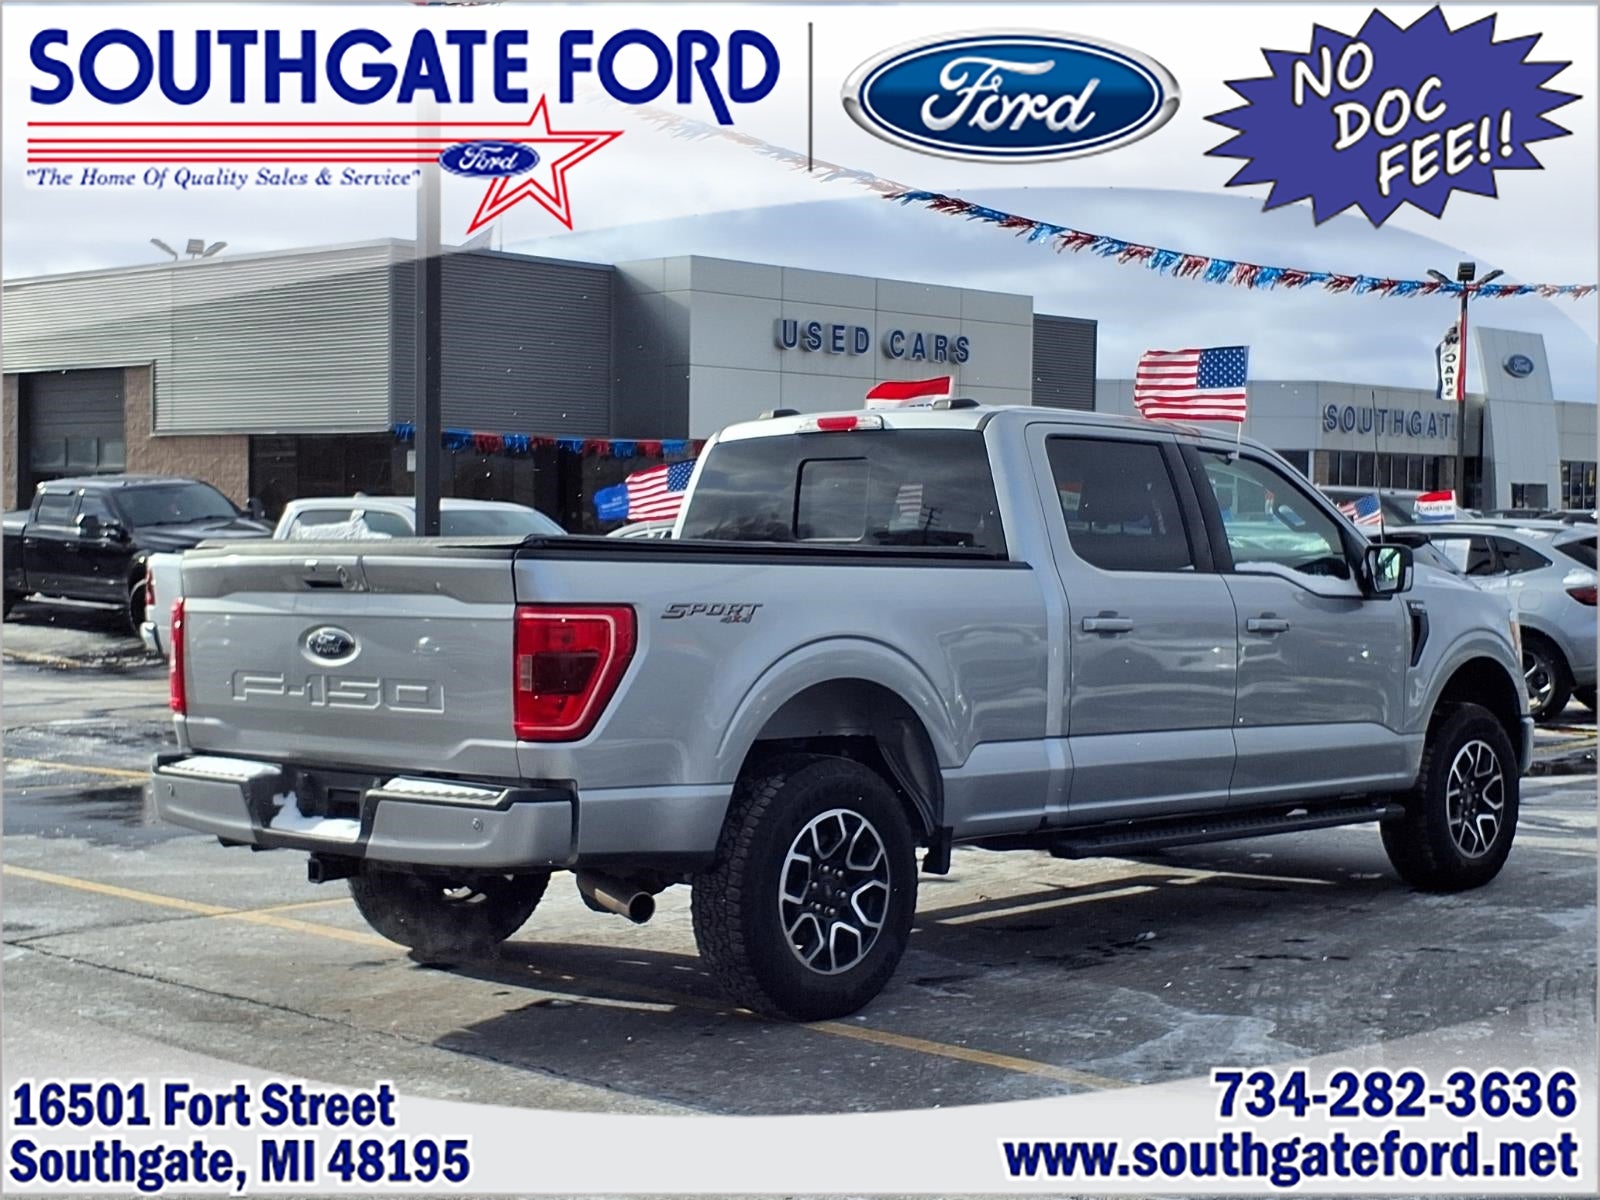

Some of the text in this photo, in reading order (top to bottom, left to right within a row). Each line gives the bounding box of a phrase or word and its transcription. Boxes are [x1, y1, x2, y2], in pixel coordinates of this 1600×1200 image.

[776, 318, 970, 364] USED CARS
[660, 602, 763, 620] SPORT
[232, 669, 445, 715] F-150
